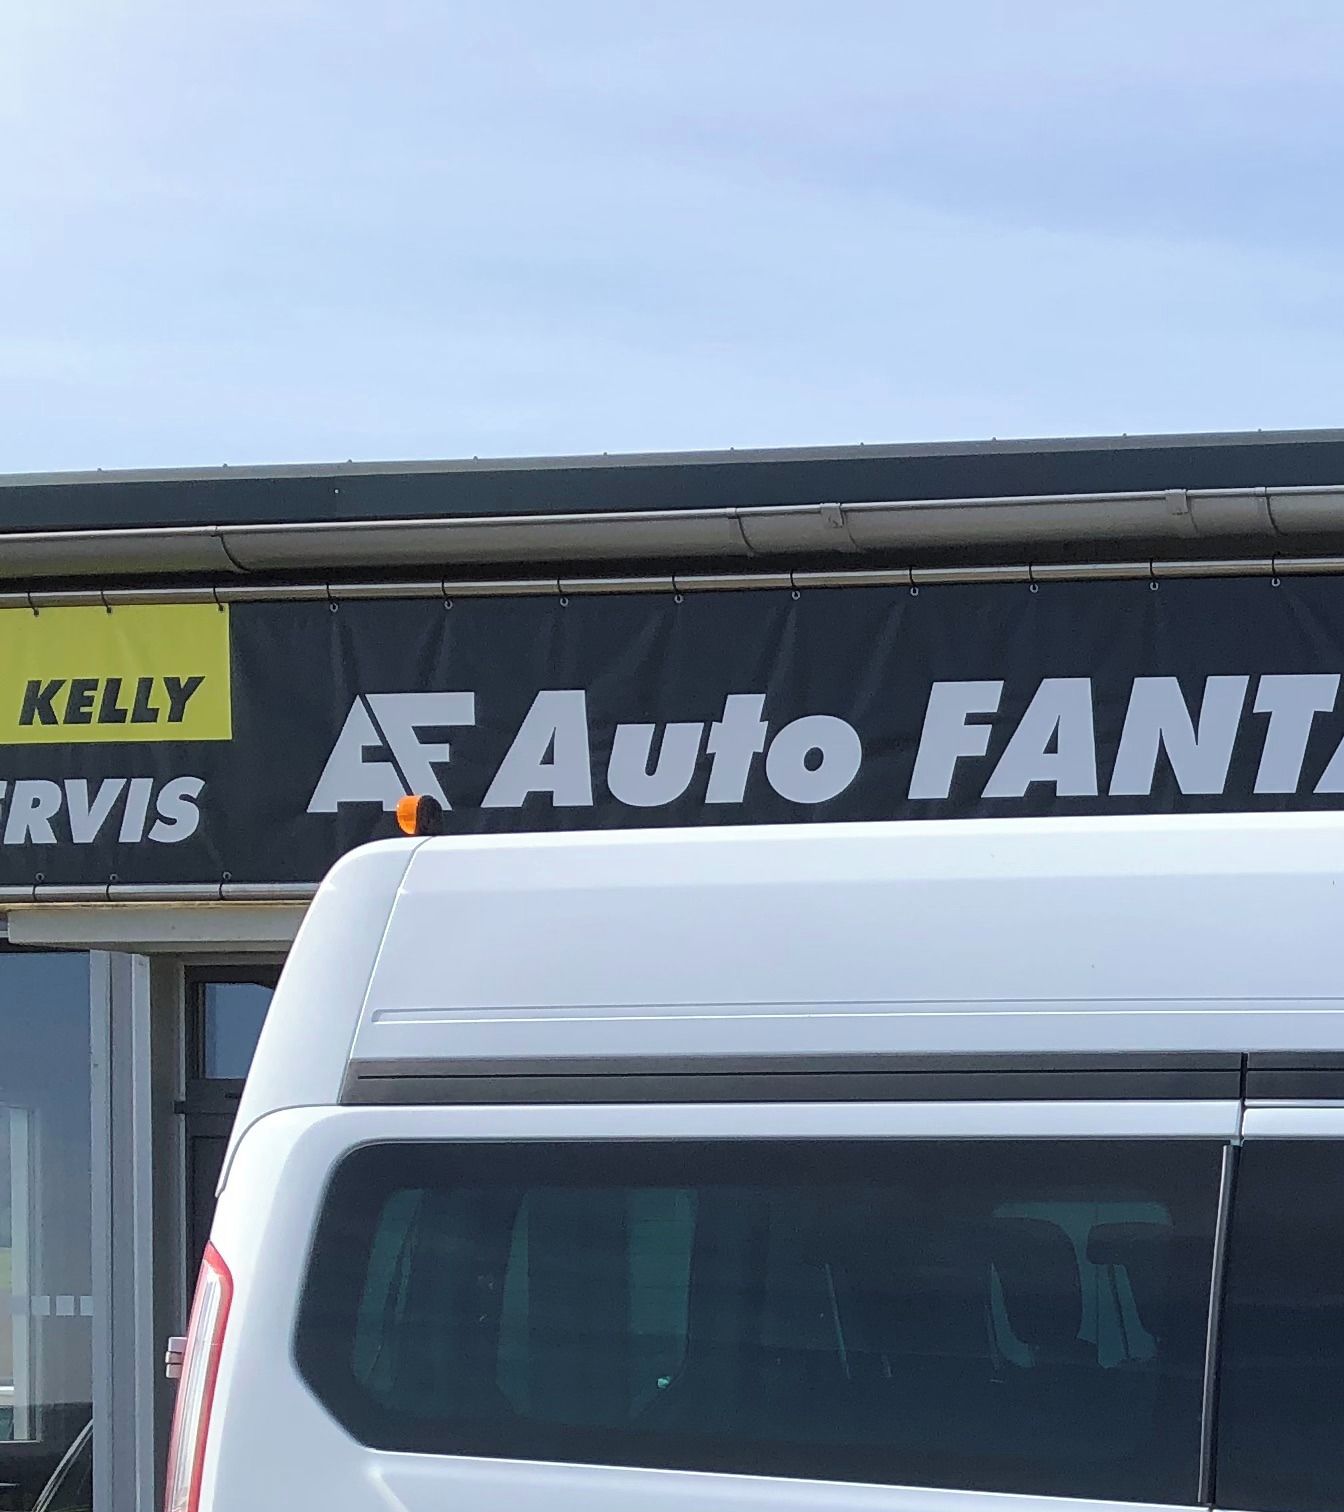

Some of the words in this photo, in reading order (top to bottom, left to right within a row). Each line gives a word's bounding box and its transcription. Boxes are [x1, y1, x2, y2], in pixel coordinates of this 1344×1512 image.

[19, 675, 206, 726] KELLY
[481, 690, 863, 808] Auto
[0, 776, 206, 845] RVIS
